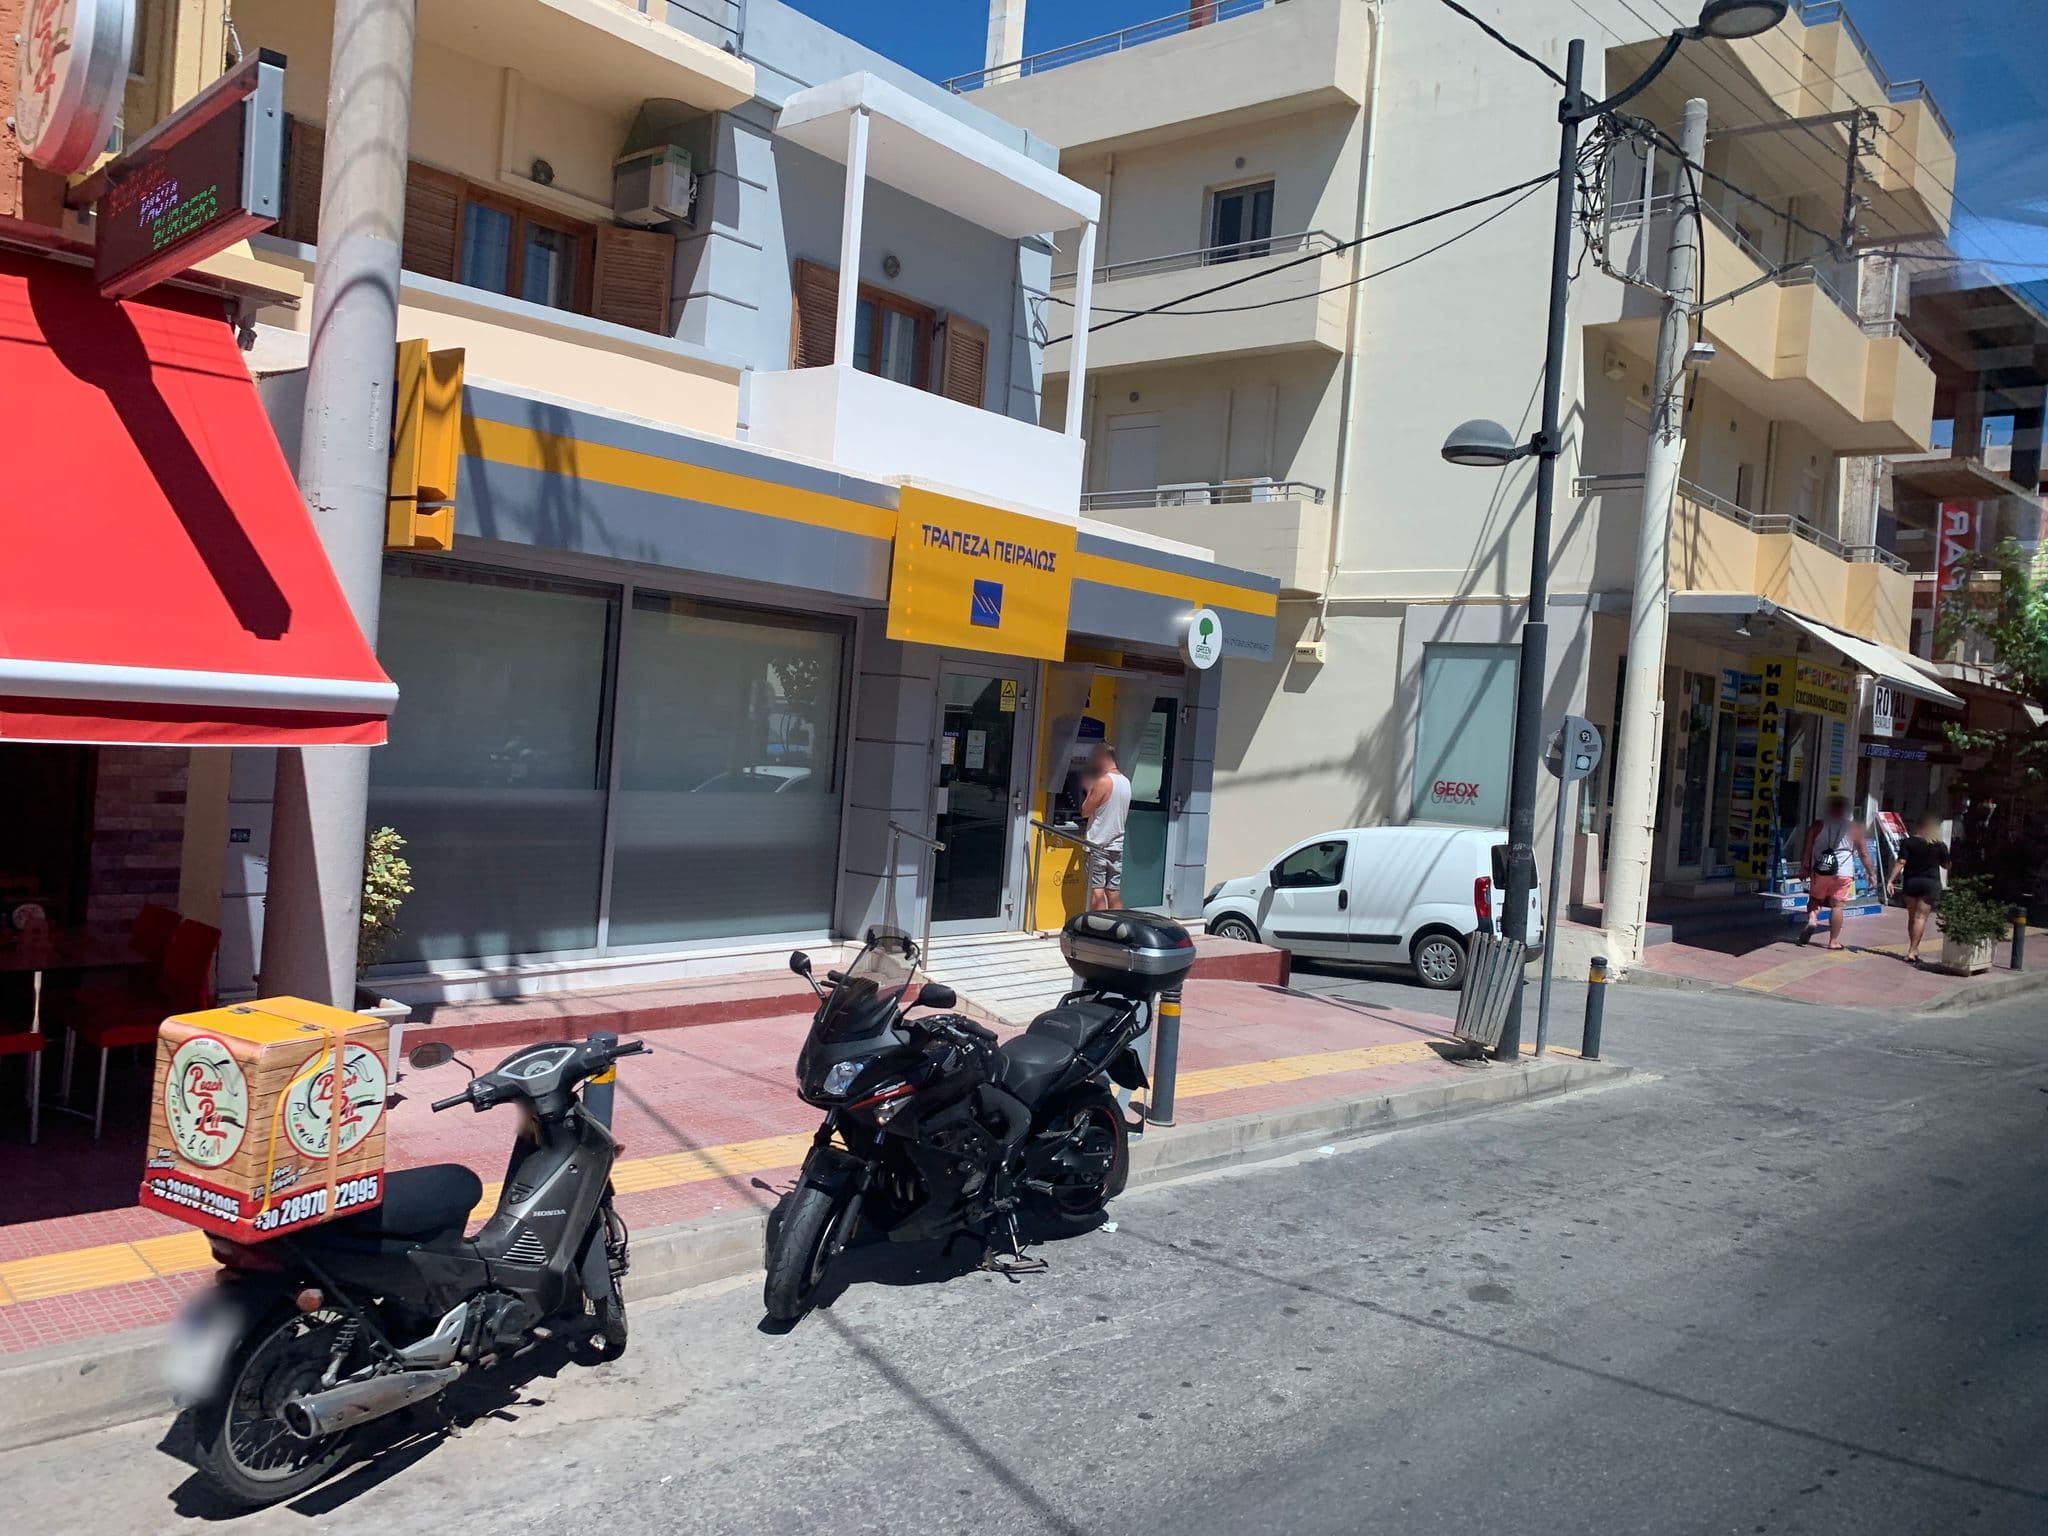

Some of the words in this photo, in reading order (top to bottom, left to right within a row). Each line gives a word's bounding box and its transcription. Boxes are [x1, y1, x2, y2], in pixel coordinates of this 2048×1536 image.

[921, 523, 991, 560] ΤΡΑΠΕΖΑ
[993, 540, 1057, 573] ΠΕΙΡΑΙΩΣ
[1762, 663, 1782, 733] ИВАН
[1876, 686, 1906, 719] ROYAL
[1433, 780, 1480, 798] GEOX
[314, 1072, 358, 1103] Pach
[254, 1208, 279, 1230] +30
[280, 1188, 328, 1225] 28970
[532, 1208, 567, 1218] HONDA
